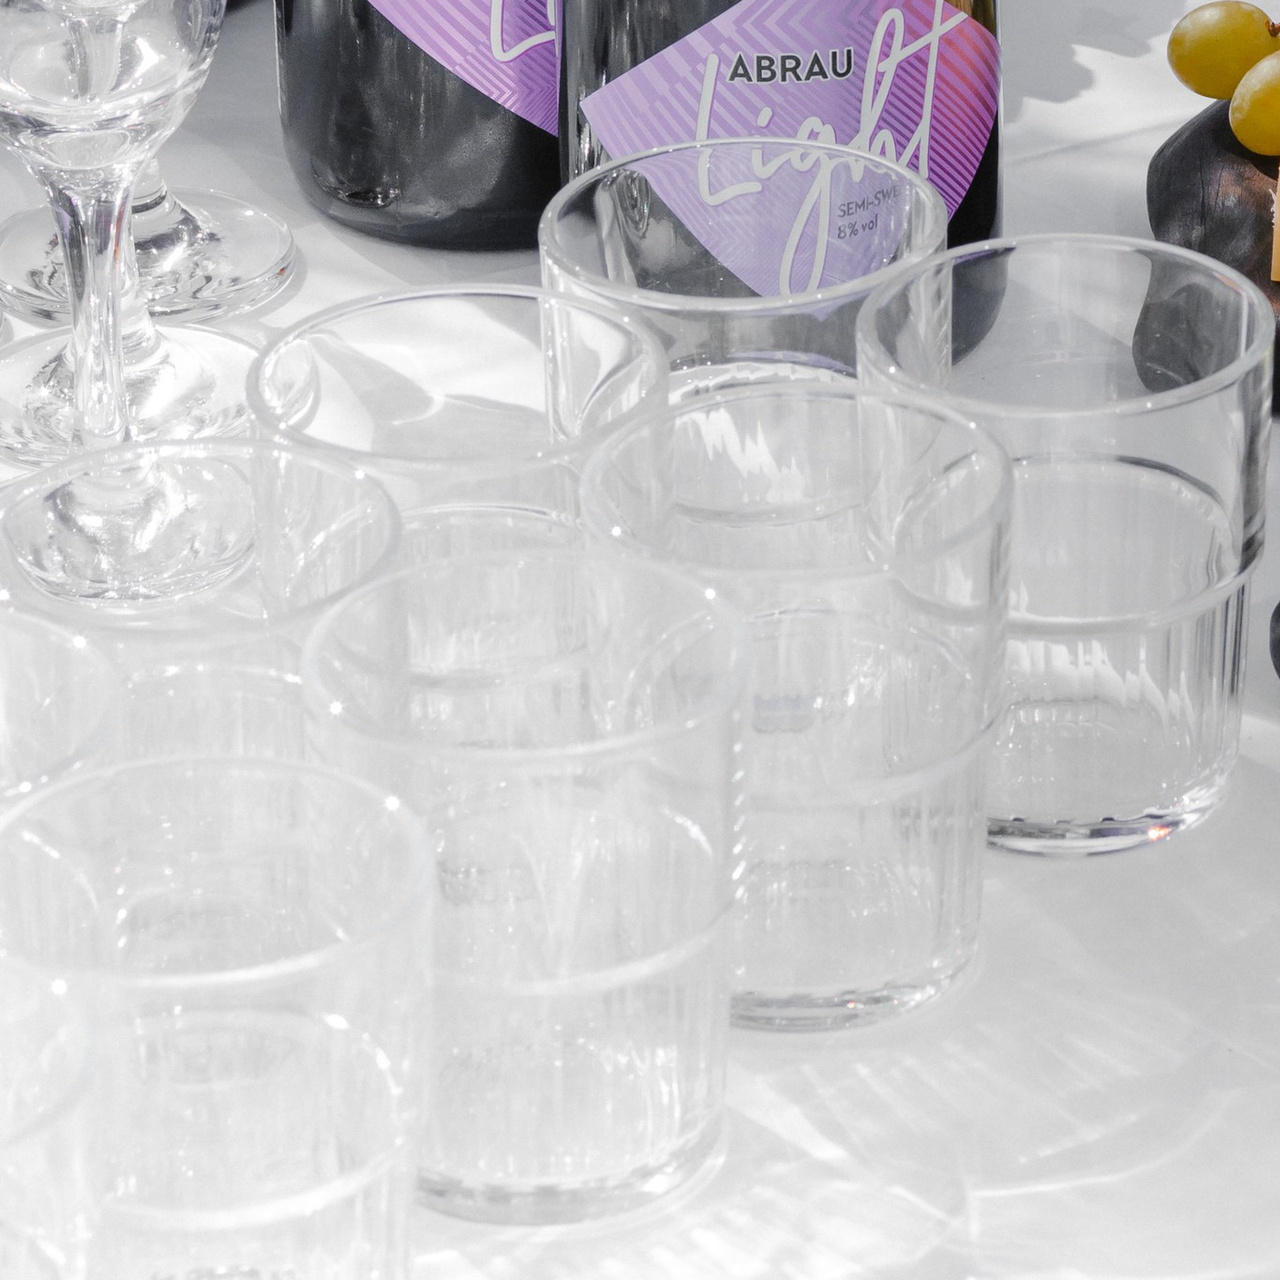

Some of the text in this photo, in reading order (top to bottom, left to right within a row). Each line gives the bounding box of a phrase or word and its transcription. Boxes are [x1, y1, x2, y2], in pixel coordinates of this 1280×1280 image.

[727, 47, 855, 84] ABRAU
[837, 213, 879, 240] 8% vol
